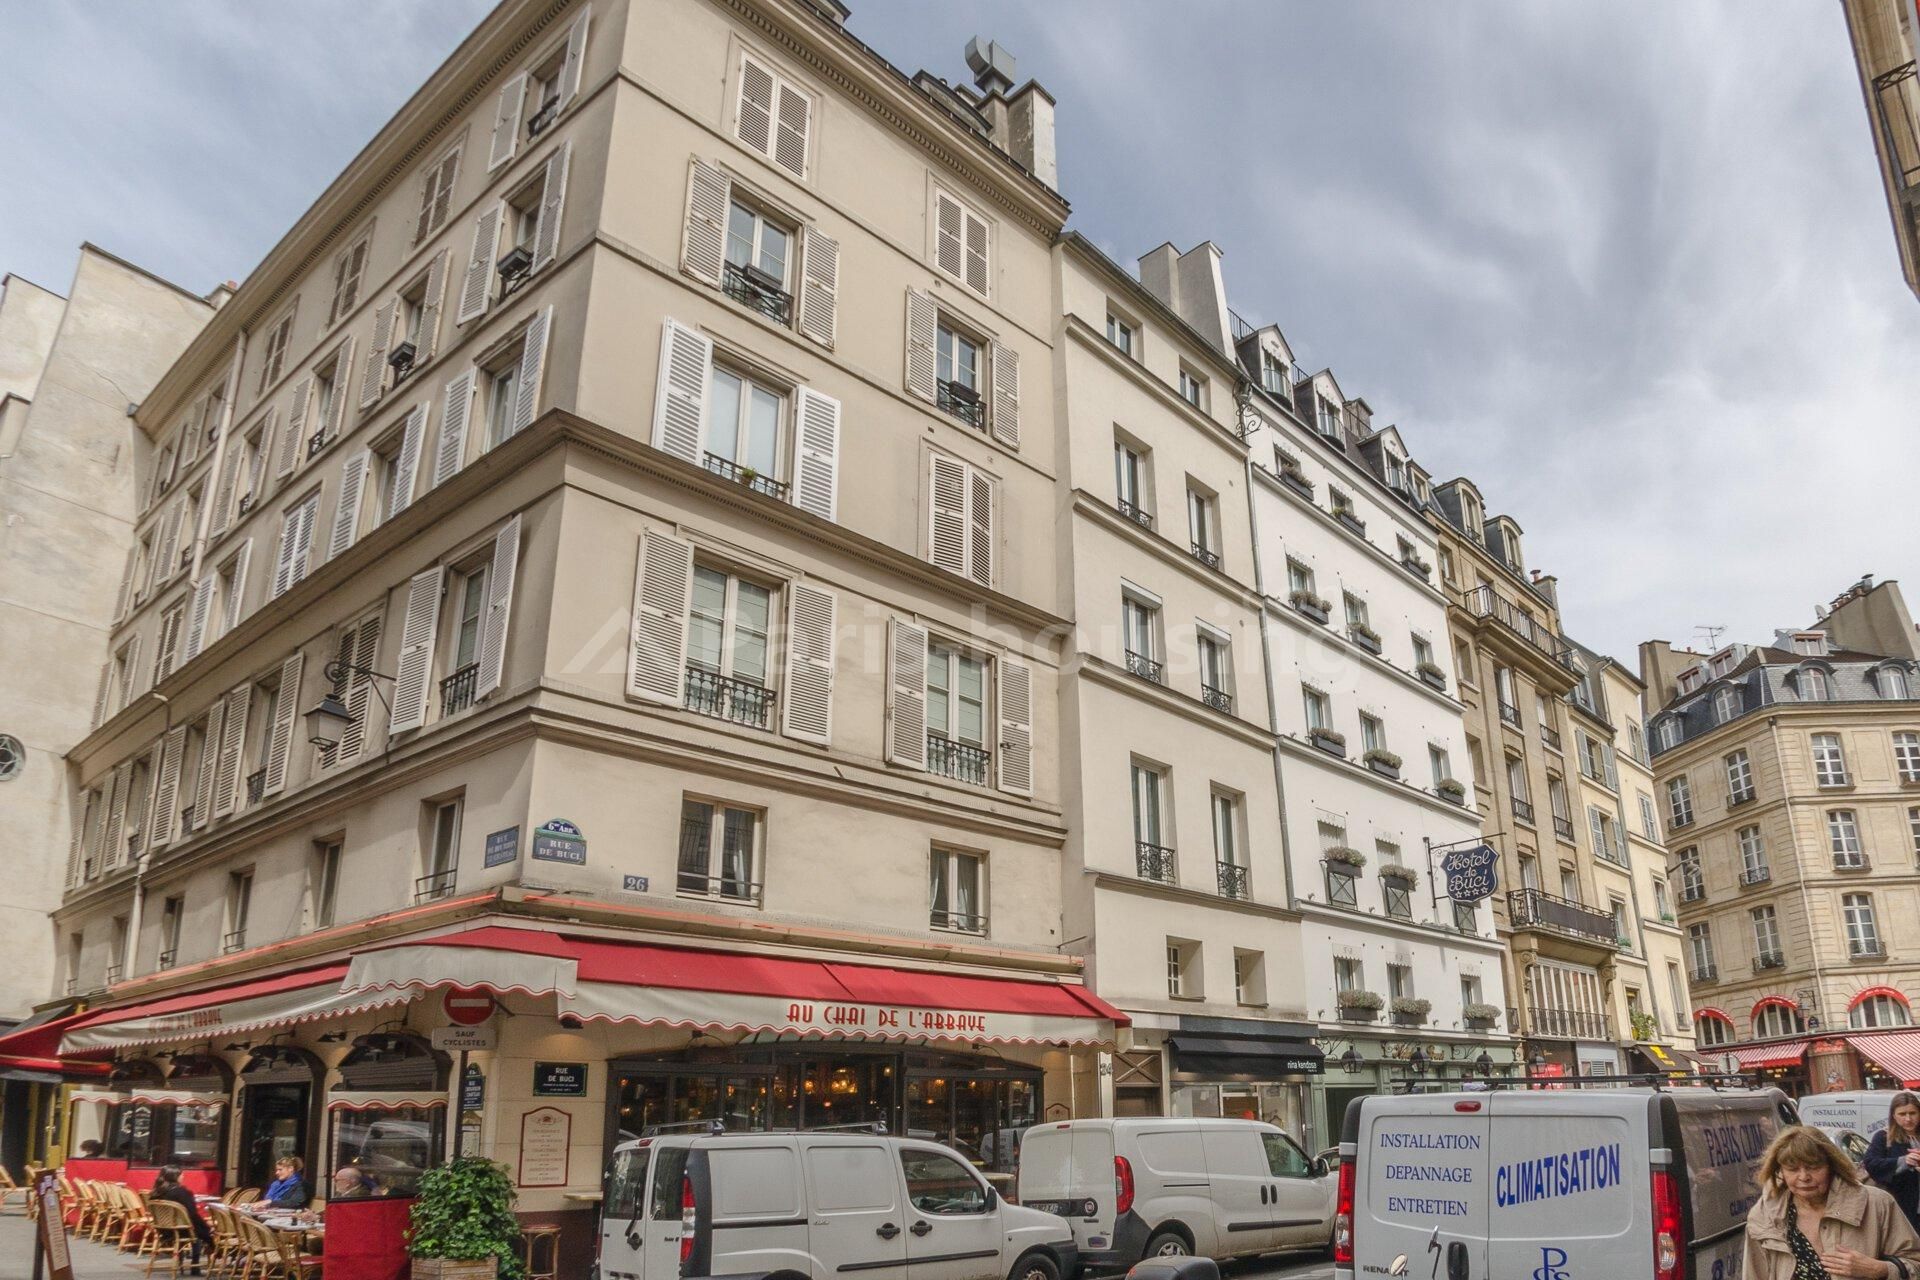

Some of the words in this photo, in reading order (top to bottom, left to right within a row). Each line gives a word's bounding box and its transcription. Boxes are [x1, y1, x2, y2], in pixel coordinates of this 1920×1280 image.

[540, 848, 553, 856] DE
[550, 840, 571, 850] RUE
[1446, 849, 1490, 871] Hotel
[1449, 868, 1489, 891] Buci
[1463, 867, 1478, 878] de
[626, 877, 645, 891] 26
[786, 1003, 813, 1023] AU
[824, 1006, 865, 1025] CHAI
[878, 1009, 898, 1027] DE
[908, 1011, 986, 1031] L'ABBAYE
[548, 1074, 557, 1082] DE
[1380, 1133, 1481, 1150] INSTALLATION
[1704, 1126, 1742, 1167] PARIS
[1386, 1165, 1472, 1183] DEPANNAGE
[1496, 1143, 1620, 1208] CLIMATISATION
[1388, 1197, 1468, 1216] ENTRETIEN
